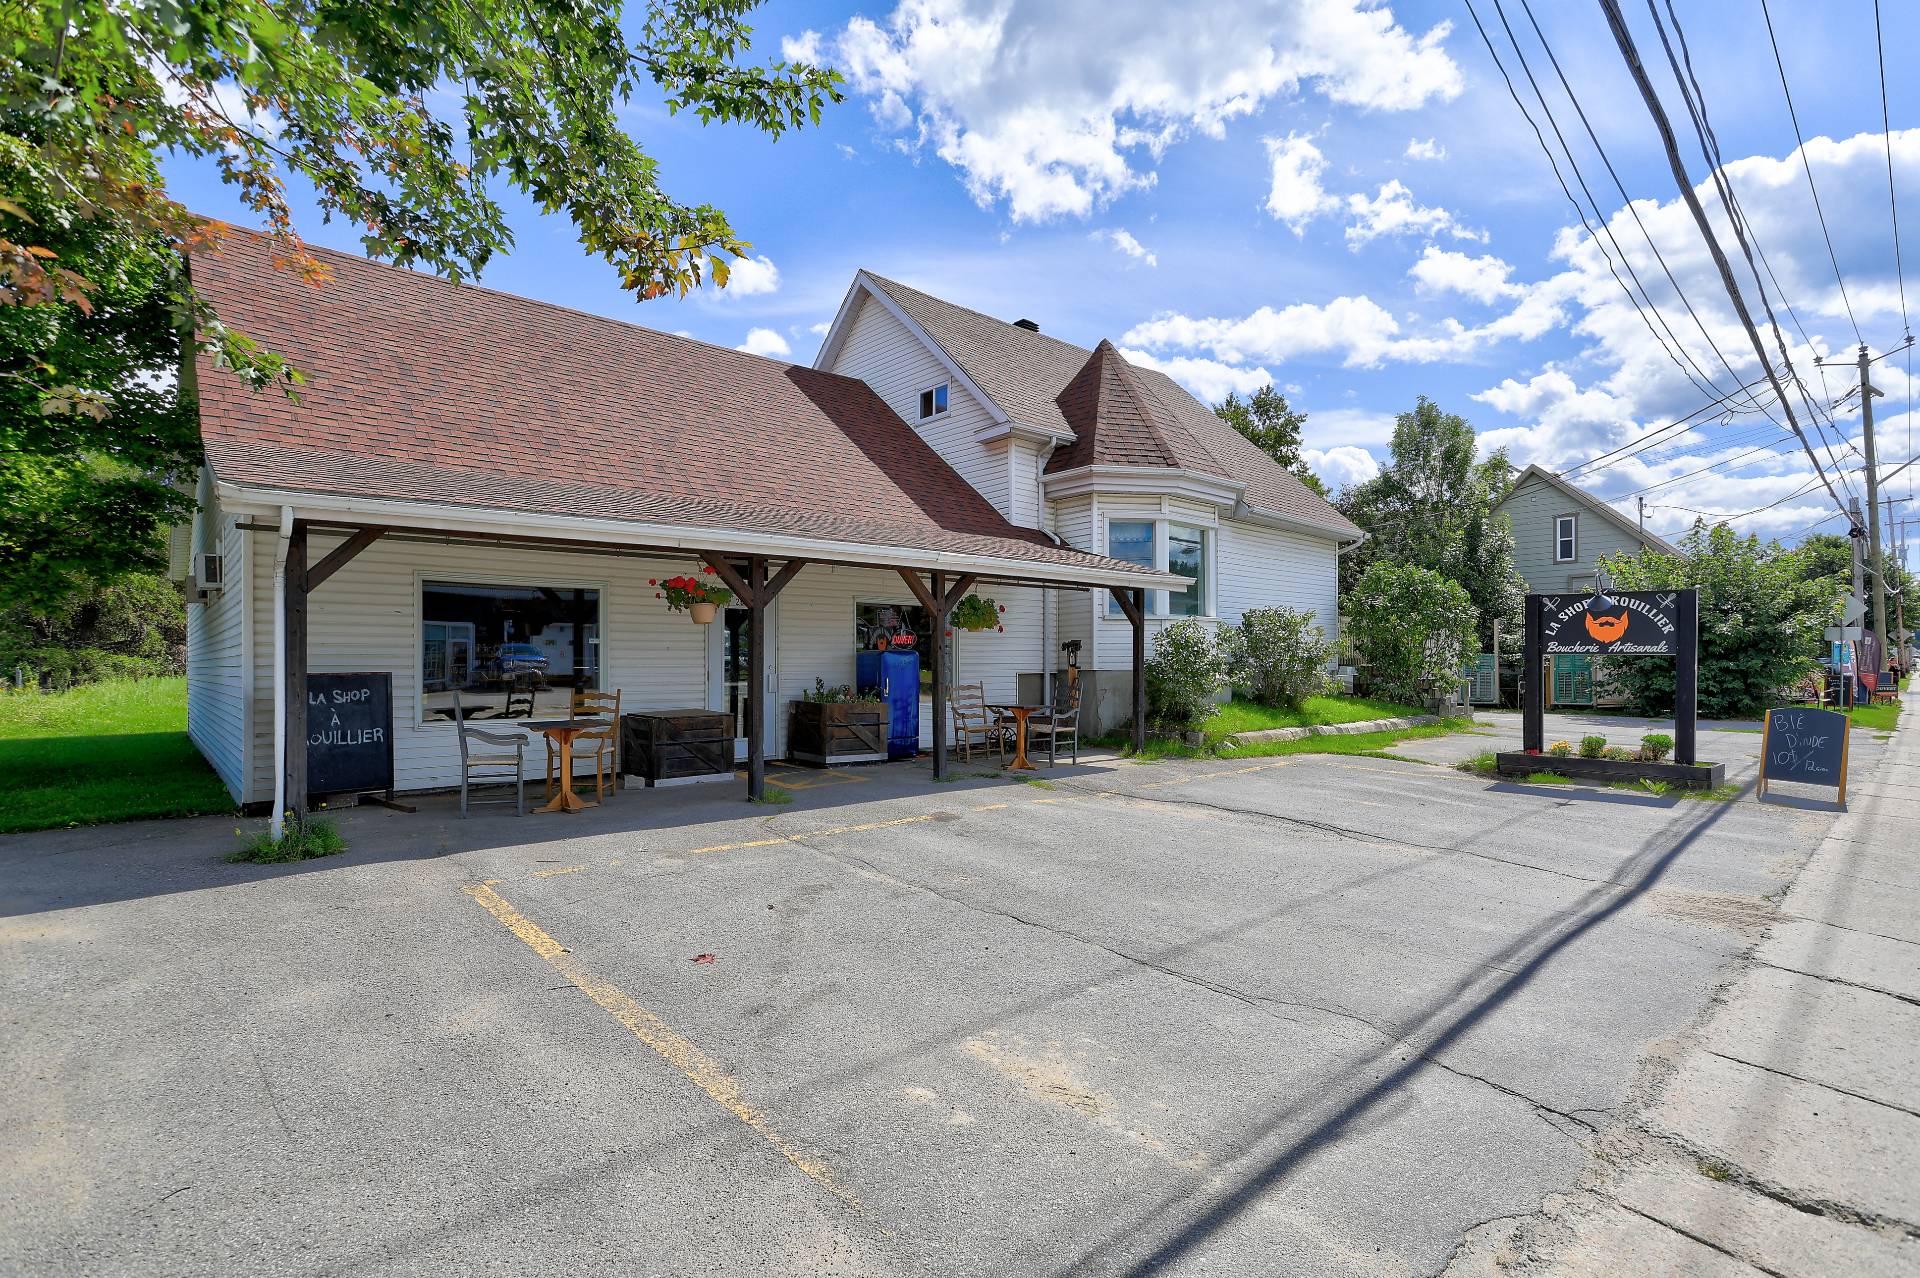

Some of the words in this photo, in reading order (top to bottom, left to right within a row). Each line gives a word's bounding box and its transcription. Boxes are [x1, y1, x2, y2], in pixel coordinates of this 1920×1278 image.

[1545, 621, 1561, 636] LA
[1610, 595, 1675, 635] ROUILLIER
[1547, 641, 1600, 653] Boucherie
[1608, 640, 1669, 653] Artisanale
[308, 691, 327, 705] LA
[332, 688, 370, 704] SHOP
[307, 727, 384, 746] OUILLIER
